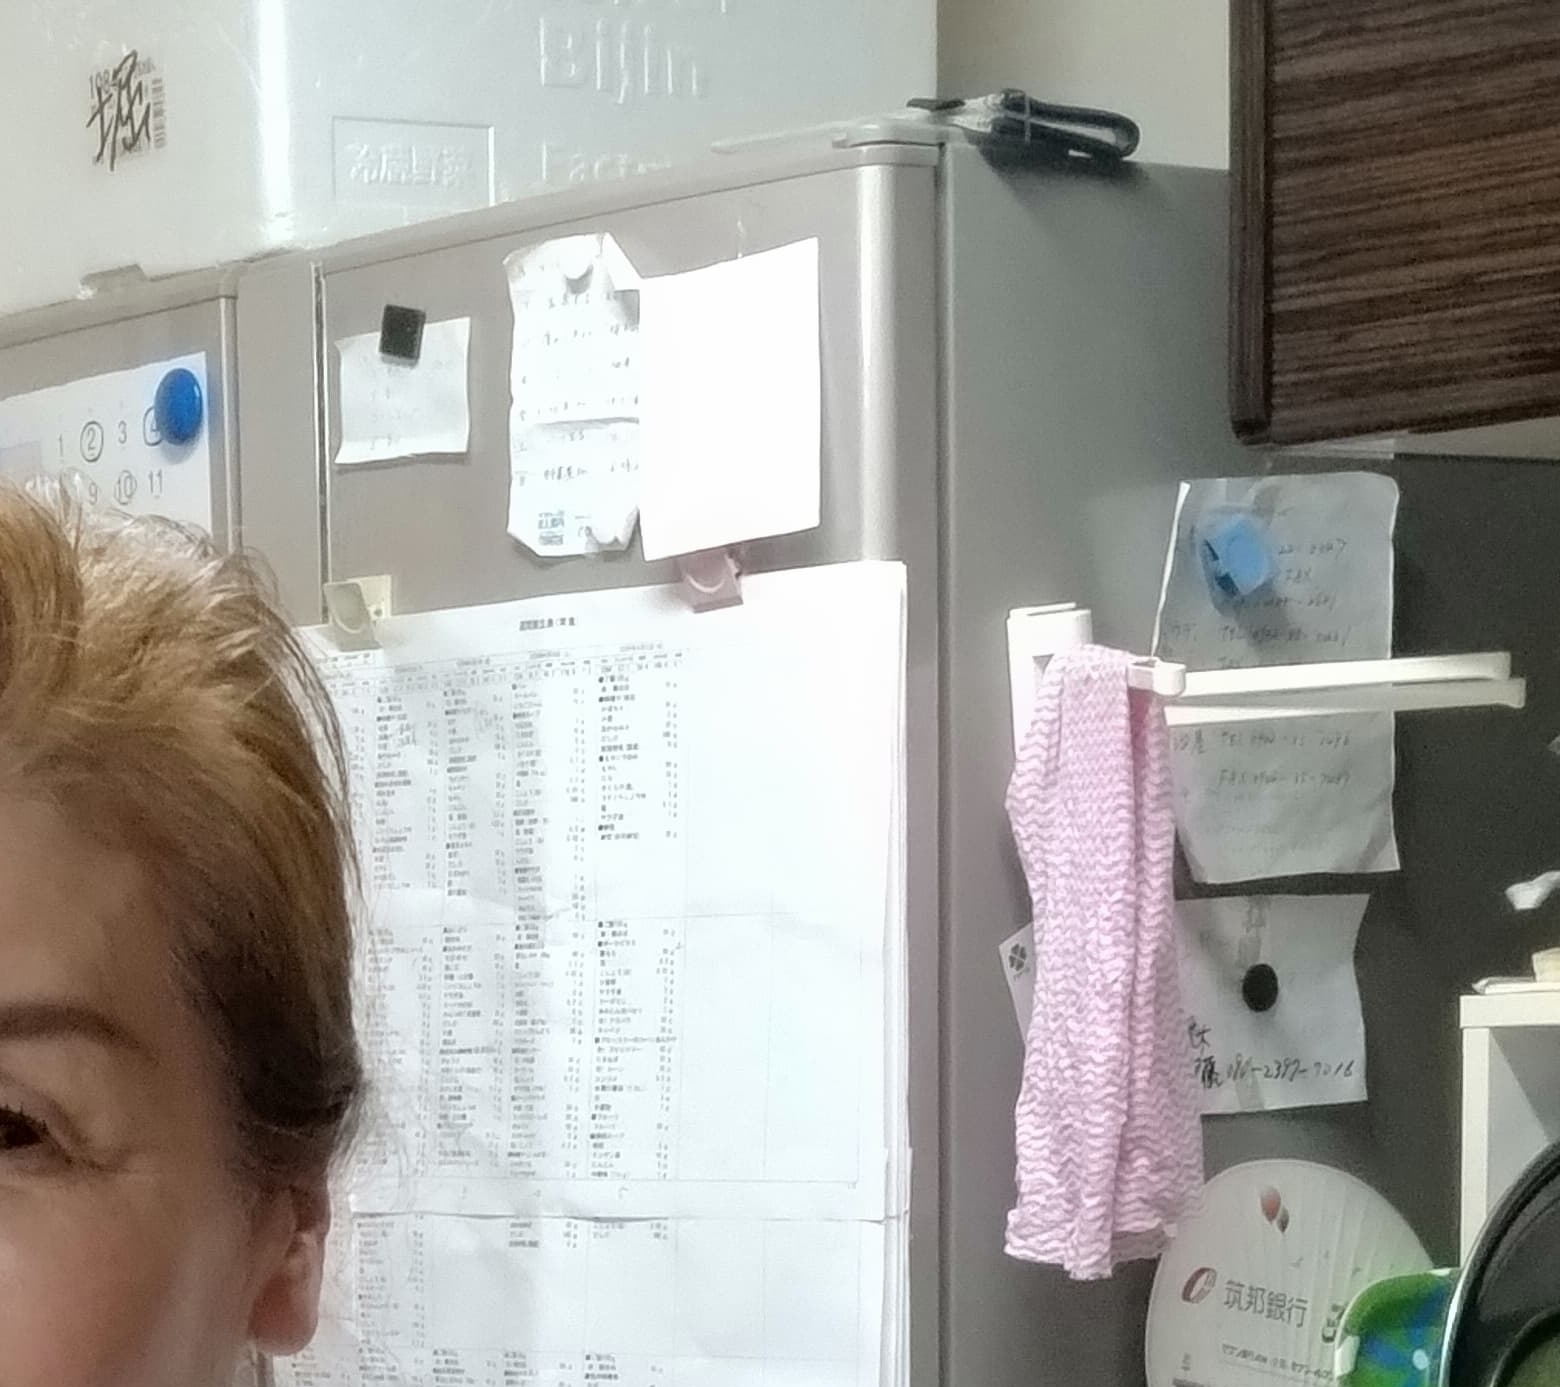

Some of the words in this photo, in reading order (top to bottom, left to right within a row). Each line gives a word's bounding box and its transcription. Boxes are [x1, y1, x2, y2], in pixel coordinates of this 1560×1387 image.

[118, 420, 128, 445] 3
[148, 468, 164, 496] 11
[1223, 1279, 1308, 1329] 筑邦銀行
